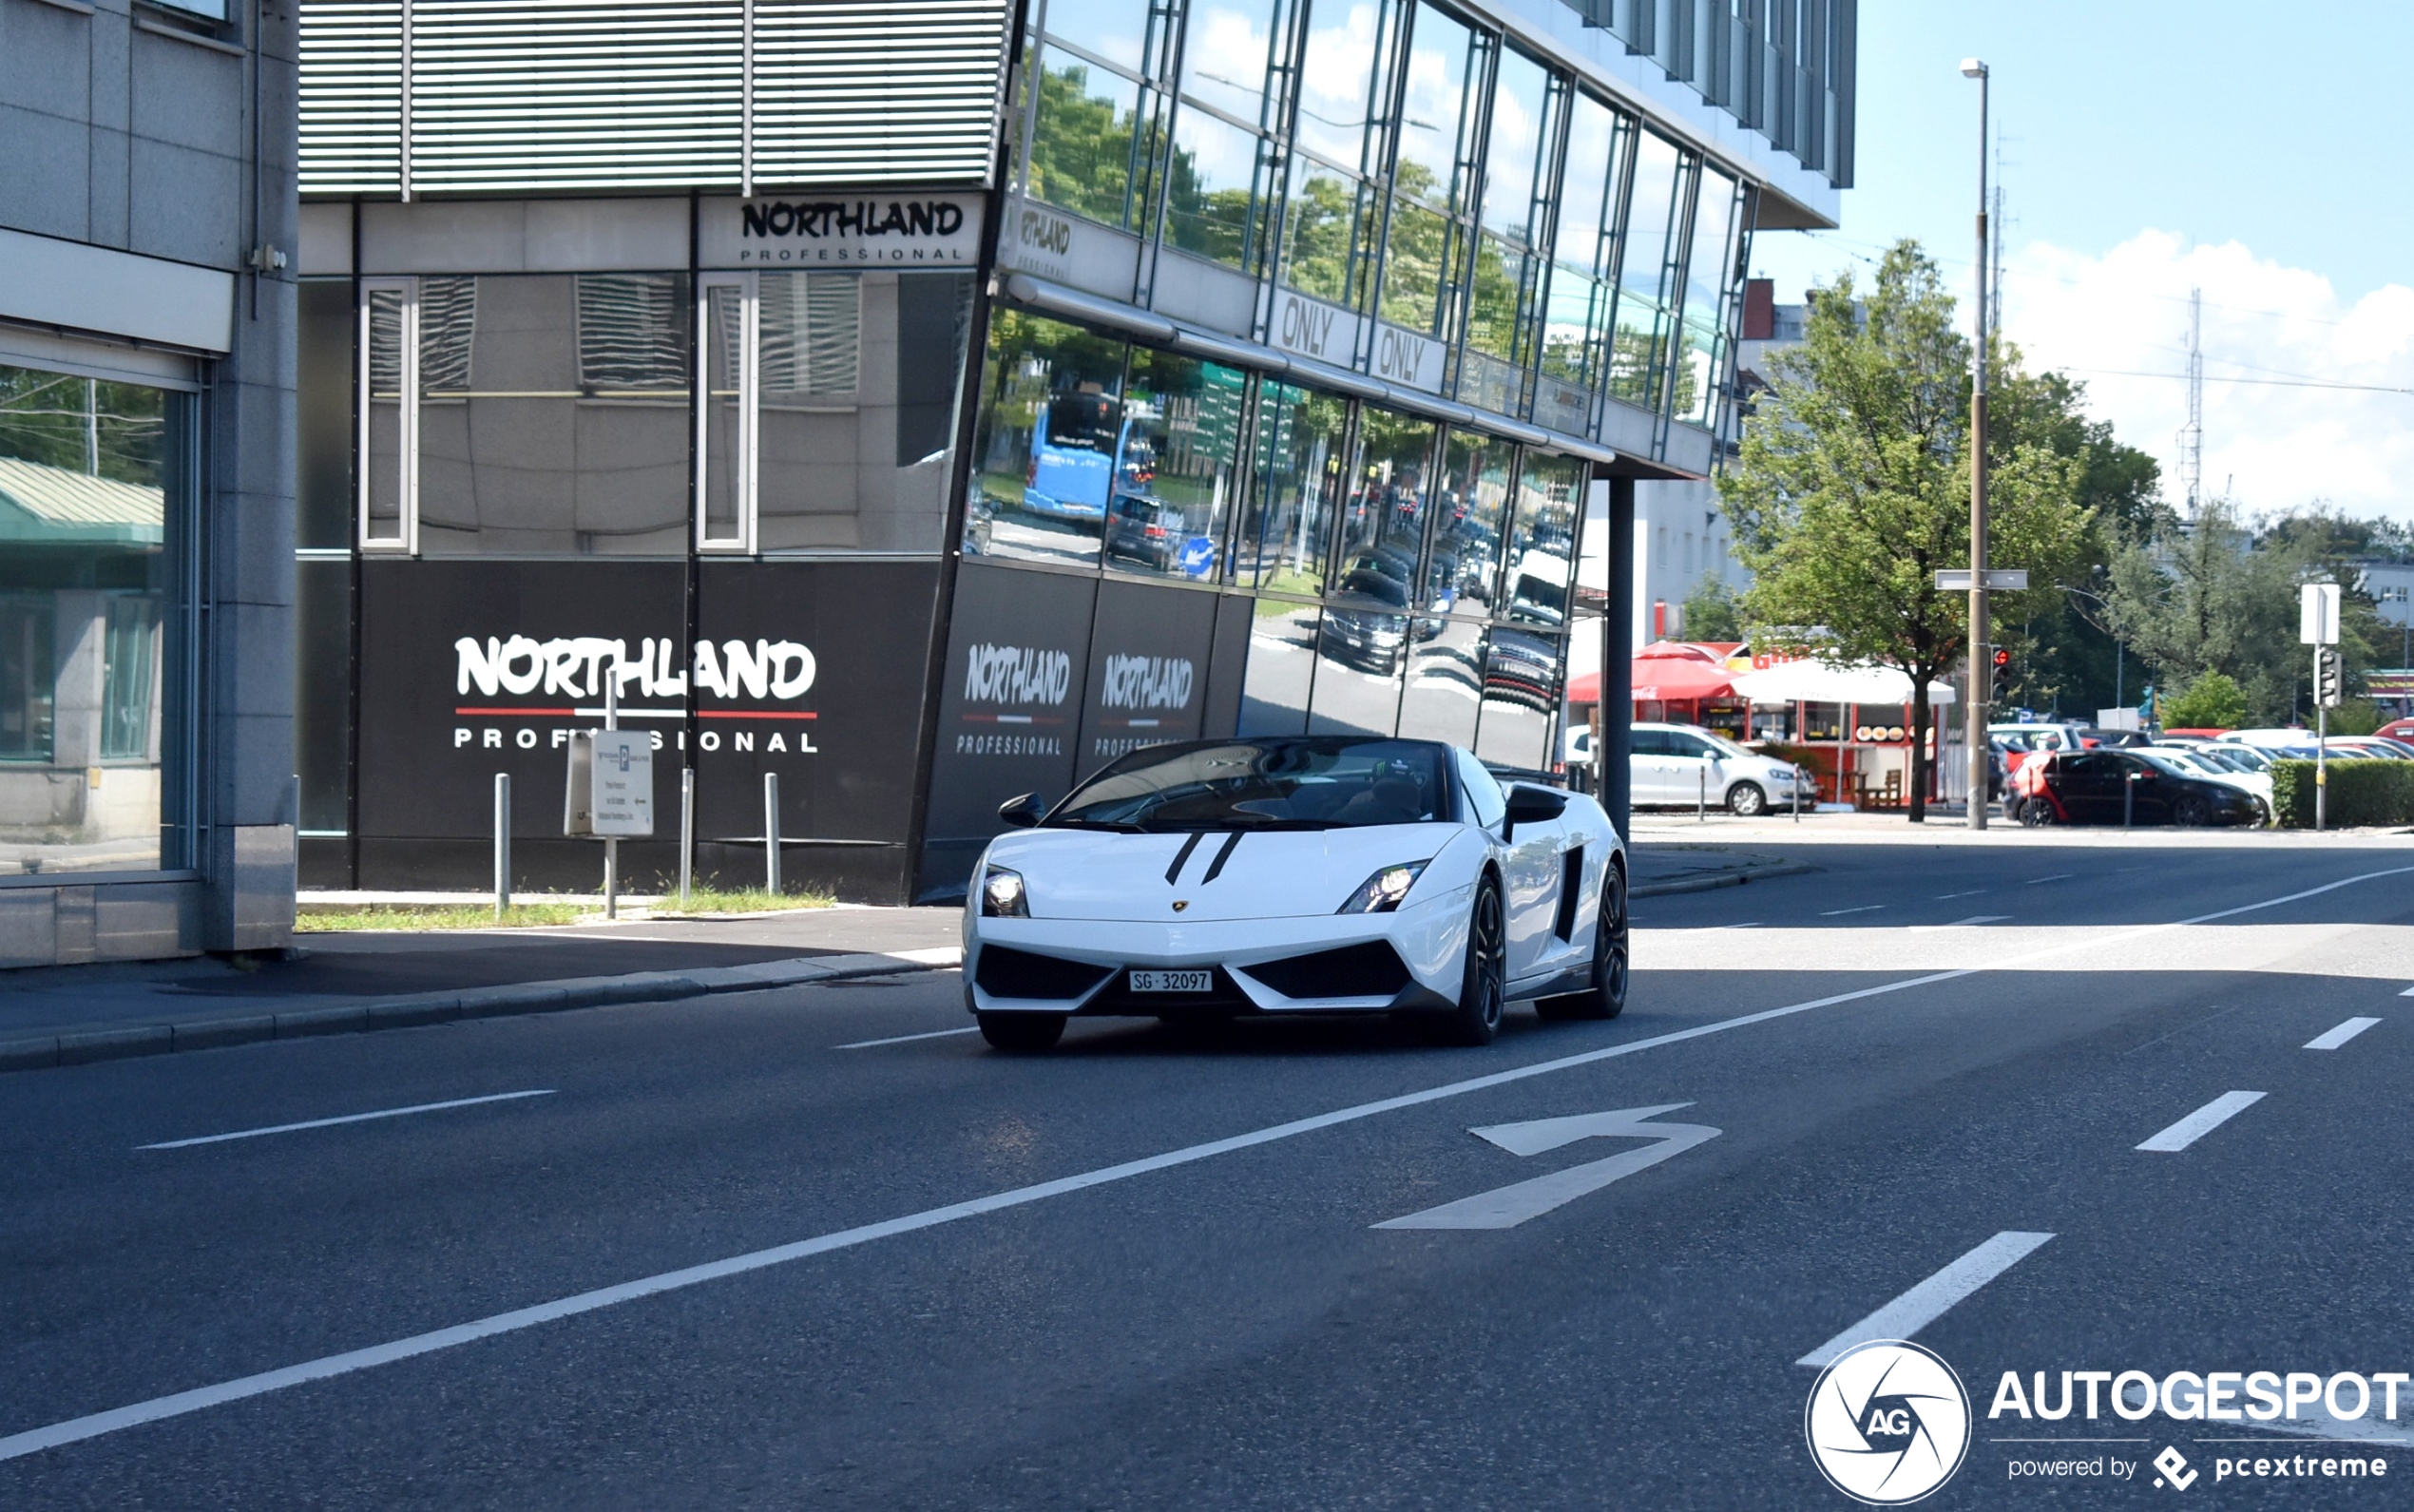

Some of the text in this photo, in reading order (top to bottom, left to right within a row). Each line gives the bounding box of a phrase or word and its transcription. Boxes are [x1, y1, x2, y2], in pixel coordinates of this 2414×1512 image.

[741, 201, 963, 238] NORTHLAND
[740, 249, 962, 260] PROFESSIONAL
[1283, 297, 1334, 357] ONLY
[1380, 329, 1426, 383] ONLY
[454, 634, 816, 699] NORTHLAND
[965, 642, 1070, 705] NORTHLAND
[1102, 653, 1193, 709] NORTHLAND
[454, 728, 817, 753] PROFSIONAL
[956, 735, 1062, 756] PROFESSIONAL
